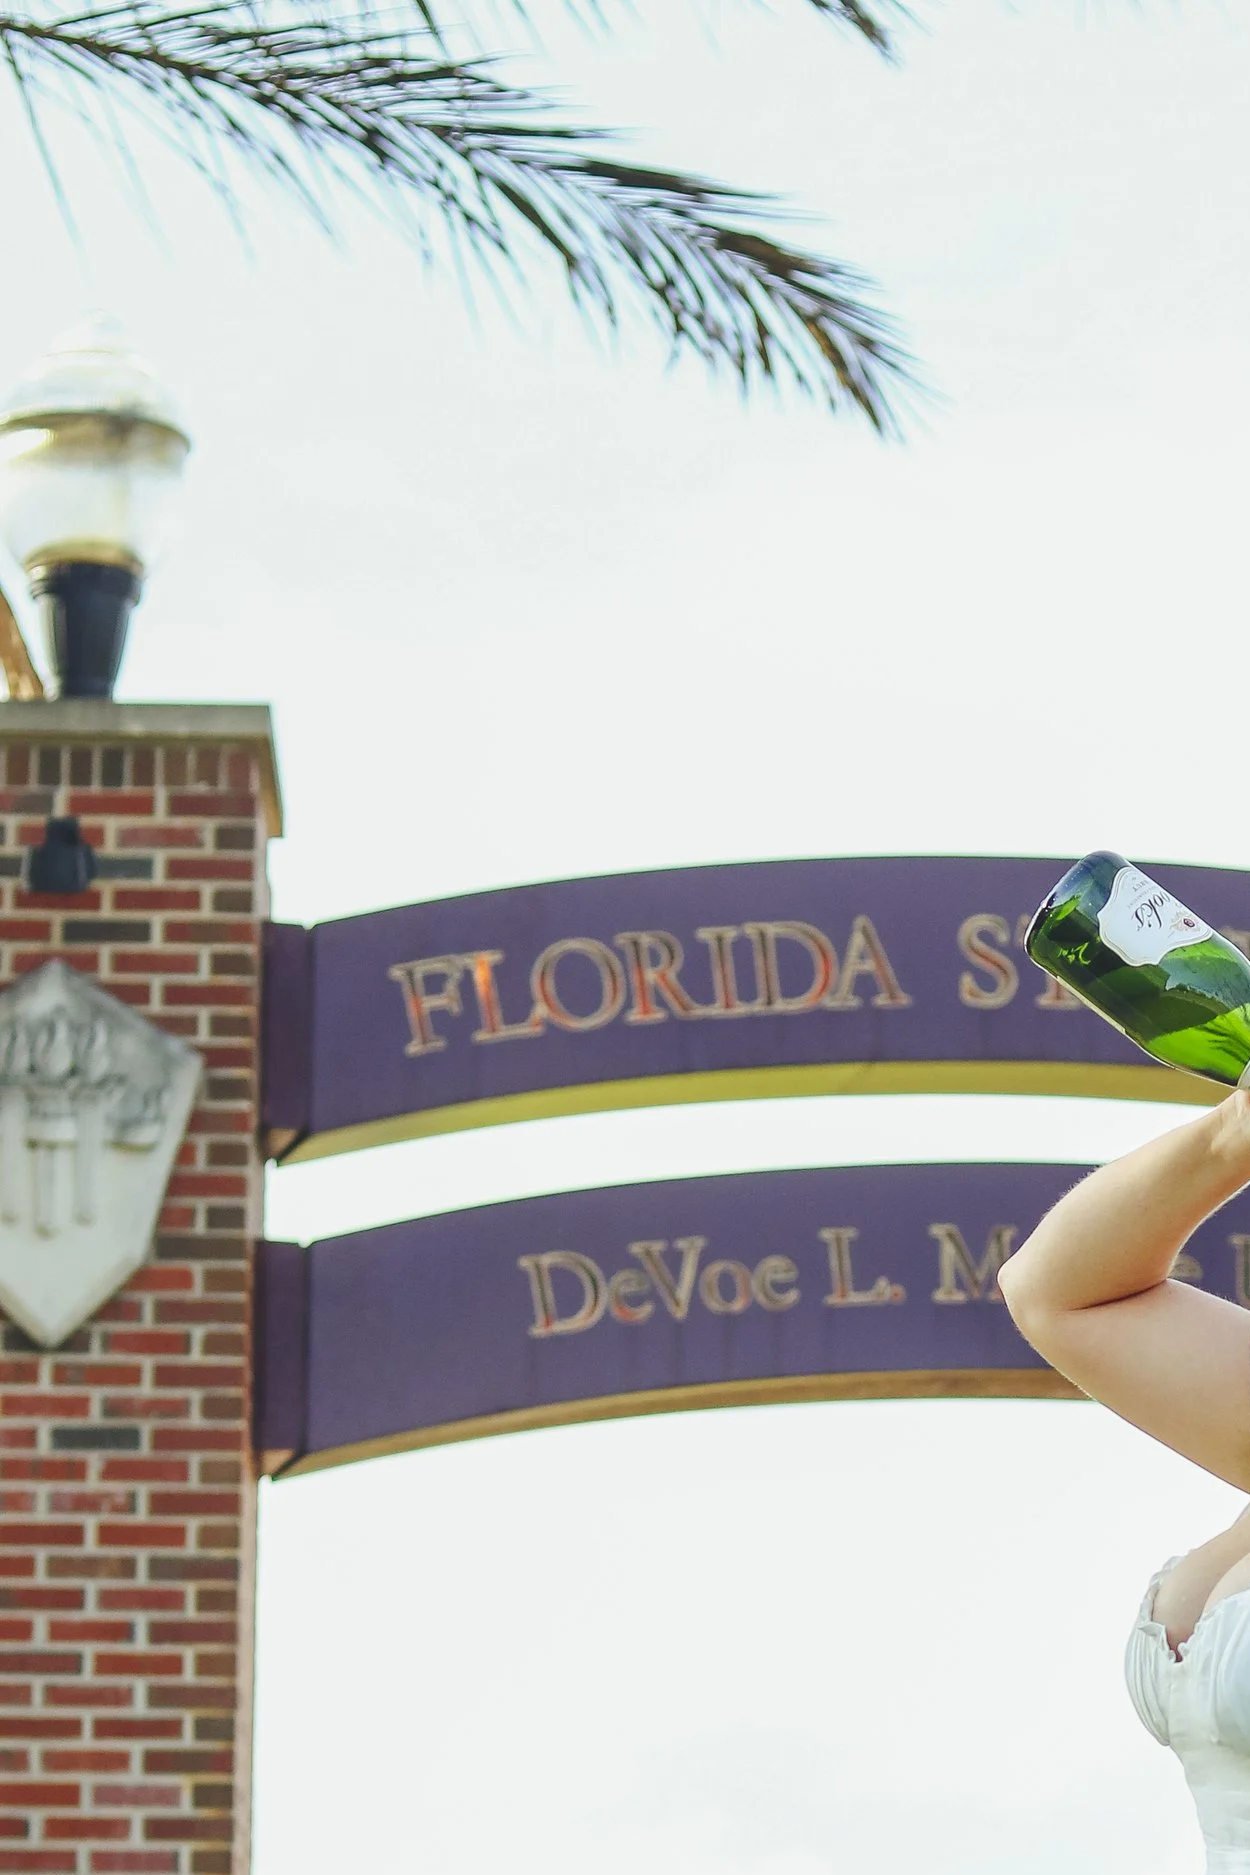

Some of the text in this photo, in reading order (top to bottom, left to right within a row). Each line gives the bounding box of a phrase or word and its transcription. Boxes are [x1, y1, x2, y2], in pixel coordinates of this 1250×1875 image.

[1131, 891, 1171, 931] ook's
[388, 914, 911, 1056] FLORIDA
[517, 1235, 800, 1338] DeVoe
[817, 1226, 906, 1307] L.
